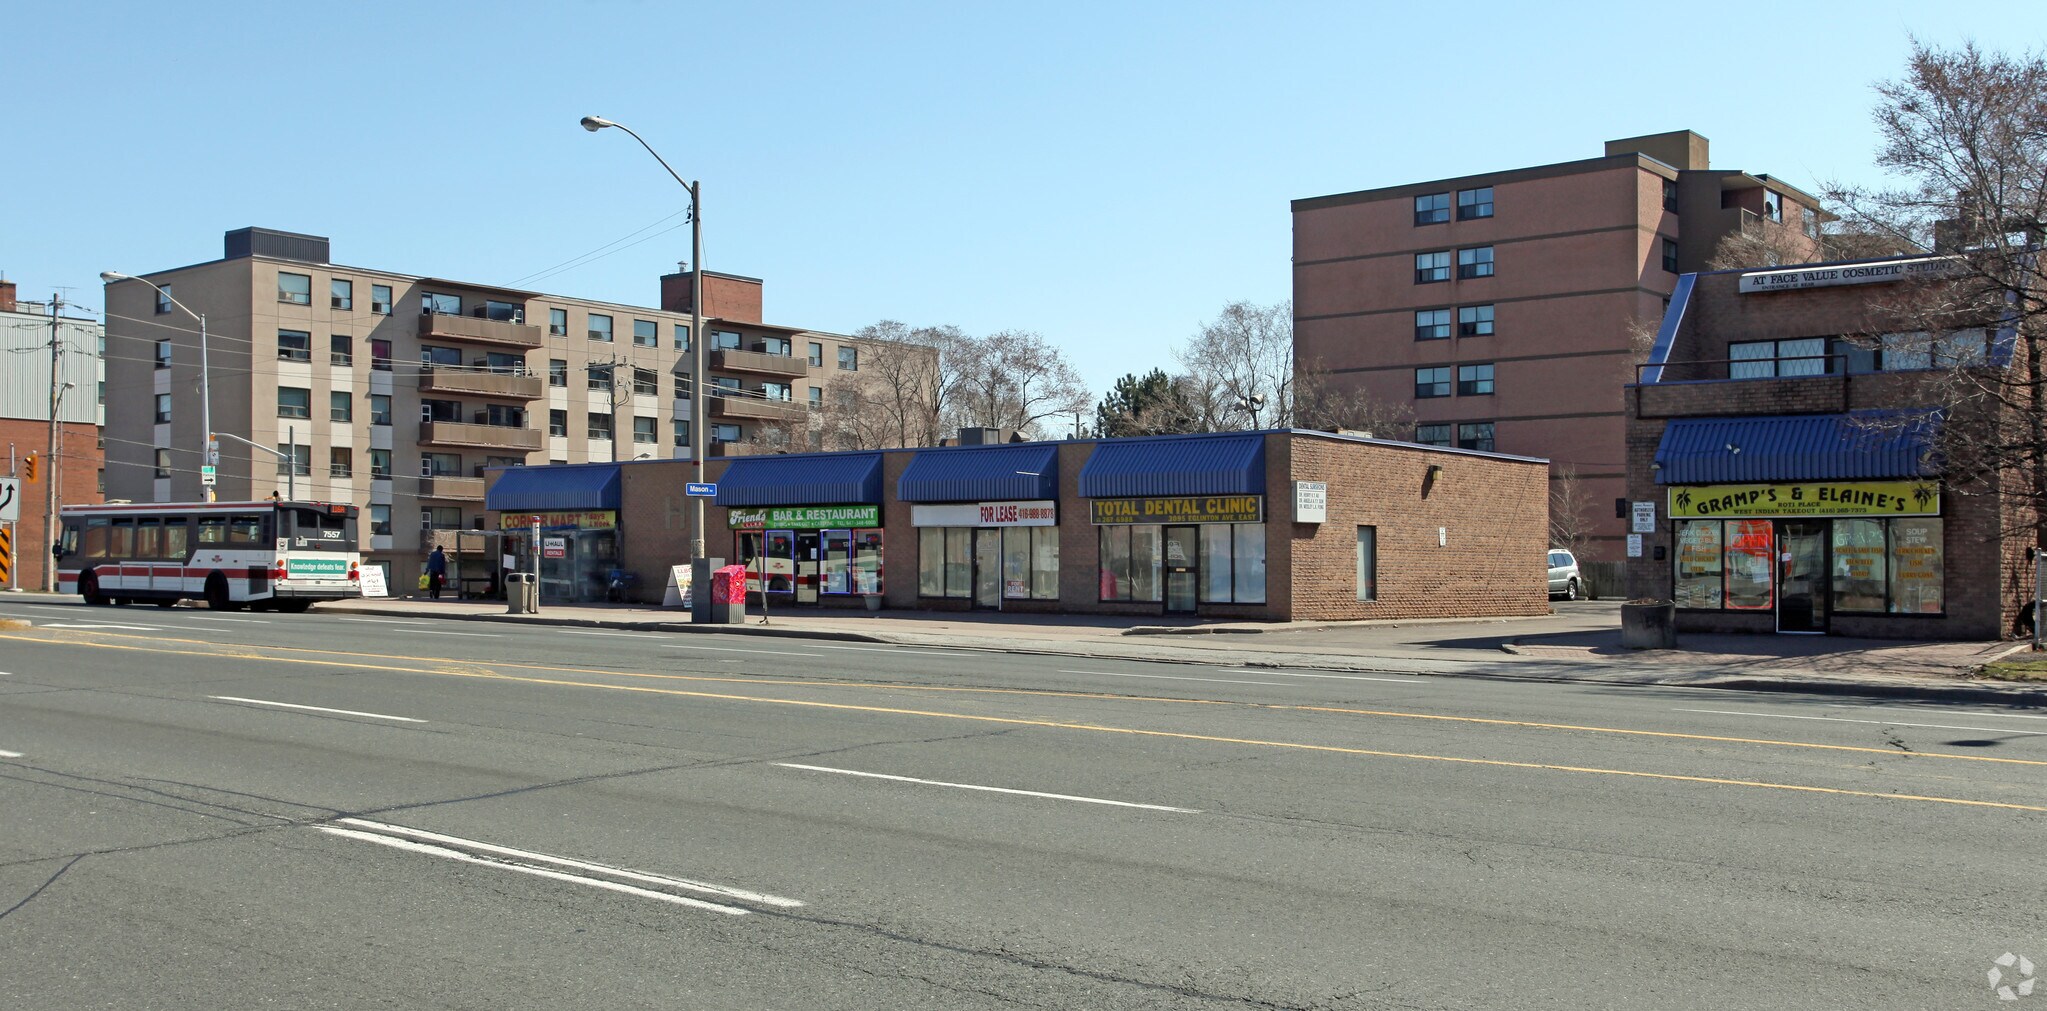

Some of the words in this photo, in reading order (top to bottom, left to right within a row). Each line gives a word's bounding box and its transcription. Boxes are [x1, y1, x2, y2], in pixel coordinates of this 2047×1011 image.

[1753, 276, 1766, 285] AT
[1771, 273, 1798, 283] FACE
[1803, 270, 1838, 281] VALUE
[1842, 266, 1901, 278] COSMETIC
[1096, 501, 1139, 516] TOTAL
[1145, 499, 1200, 515] DENTAL
[1206, 497, 1256, 513] CLINIC
[1697, 487, 1777, 514] GRAMP'S
[1791, 487, 1803, 500] &
[1819, 487, 1906, 512] ELAINE'S
[505, 515, 548, 528] CORNR
[550, 514, 582, 526] MART
[773, 510, 793, 521] BAR
[796, 509, 803, 520] &
[806, 508, 876, 520] RESTAURANT
[980, 506, 994, 522] FOR
[996, 505, 1018, 522] LEASE
[1731, 535, 1767, 548] OPEN
[290, 563, 316, 571] Knowledge
